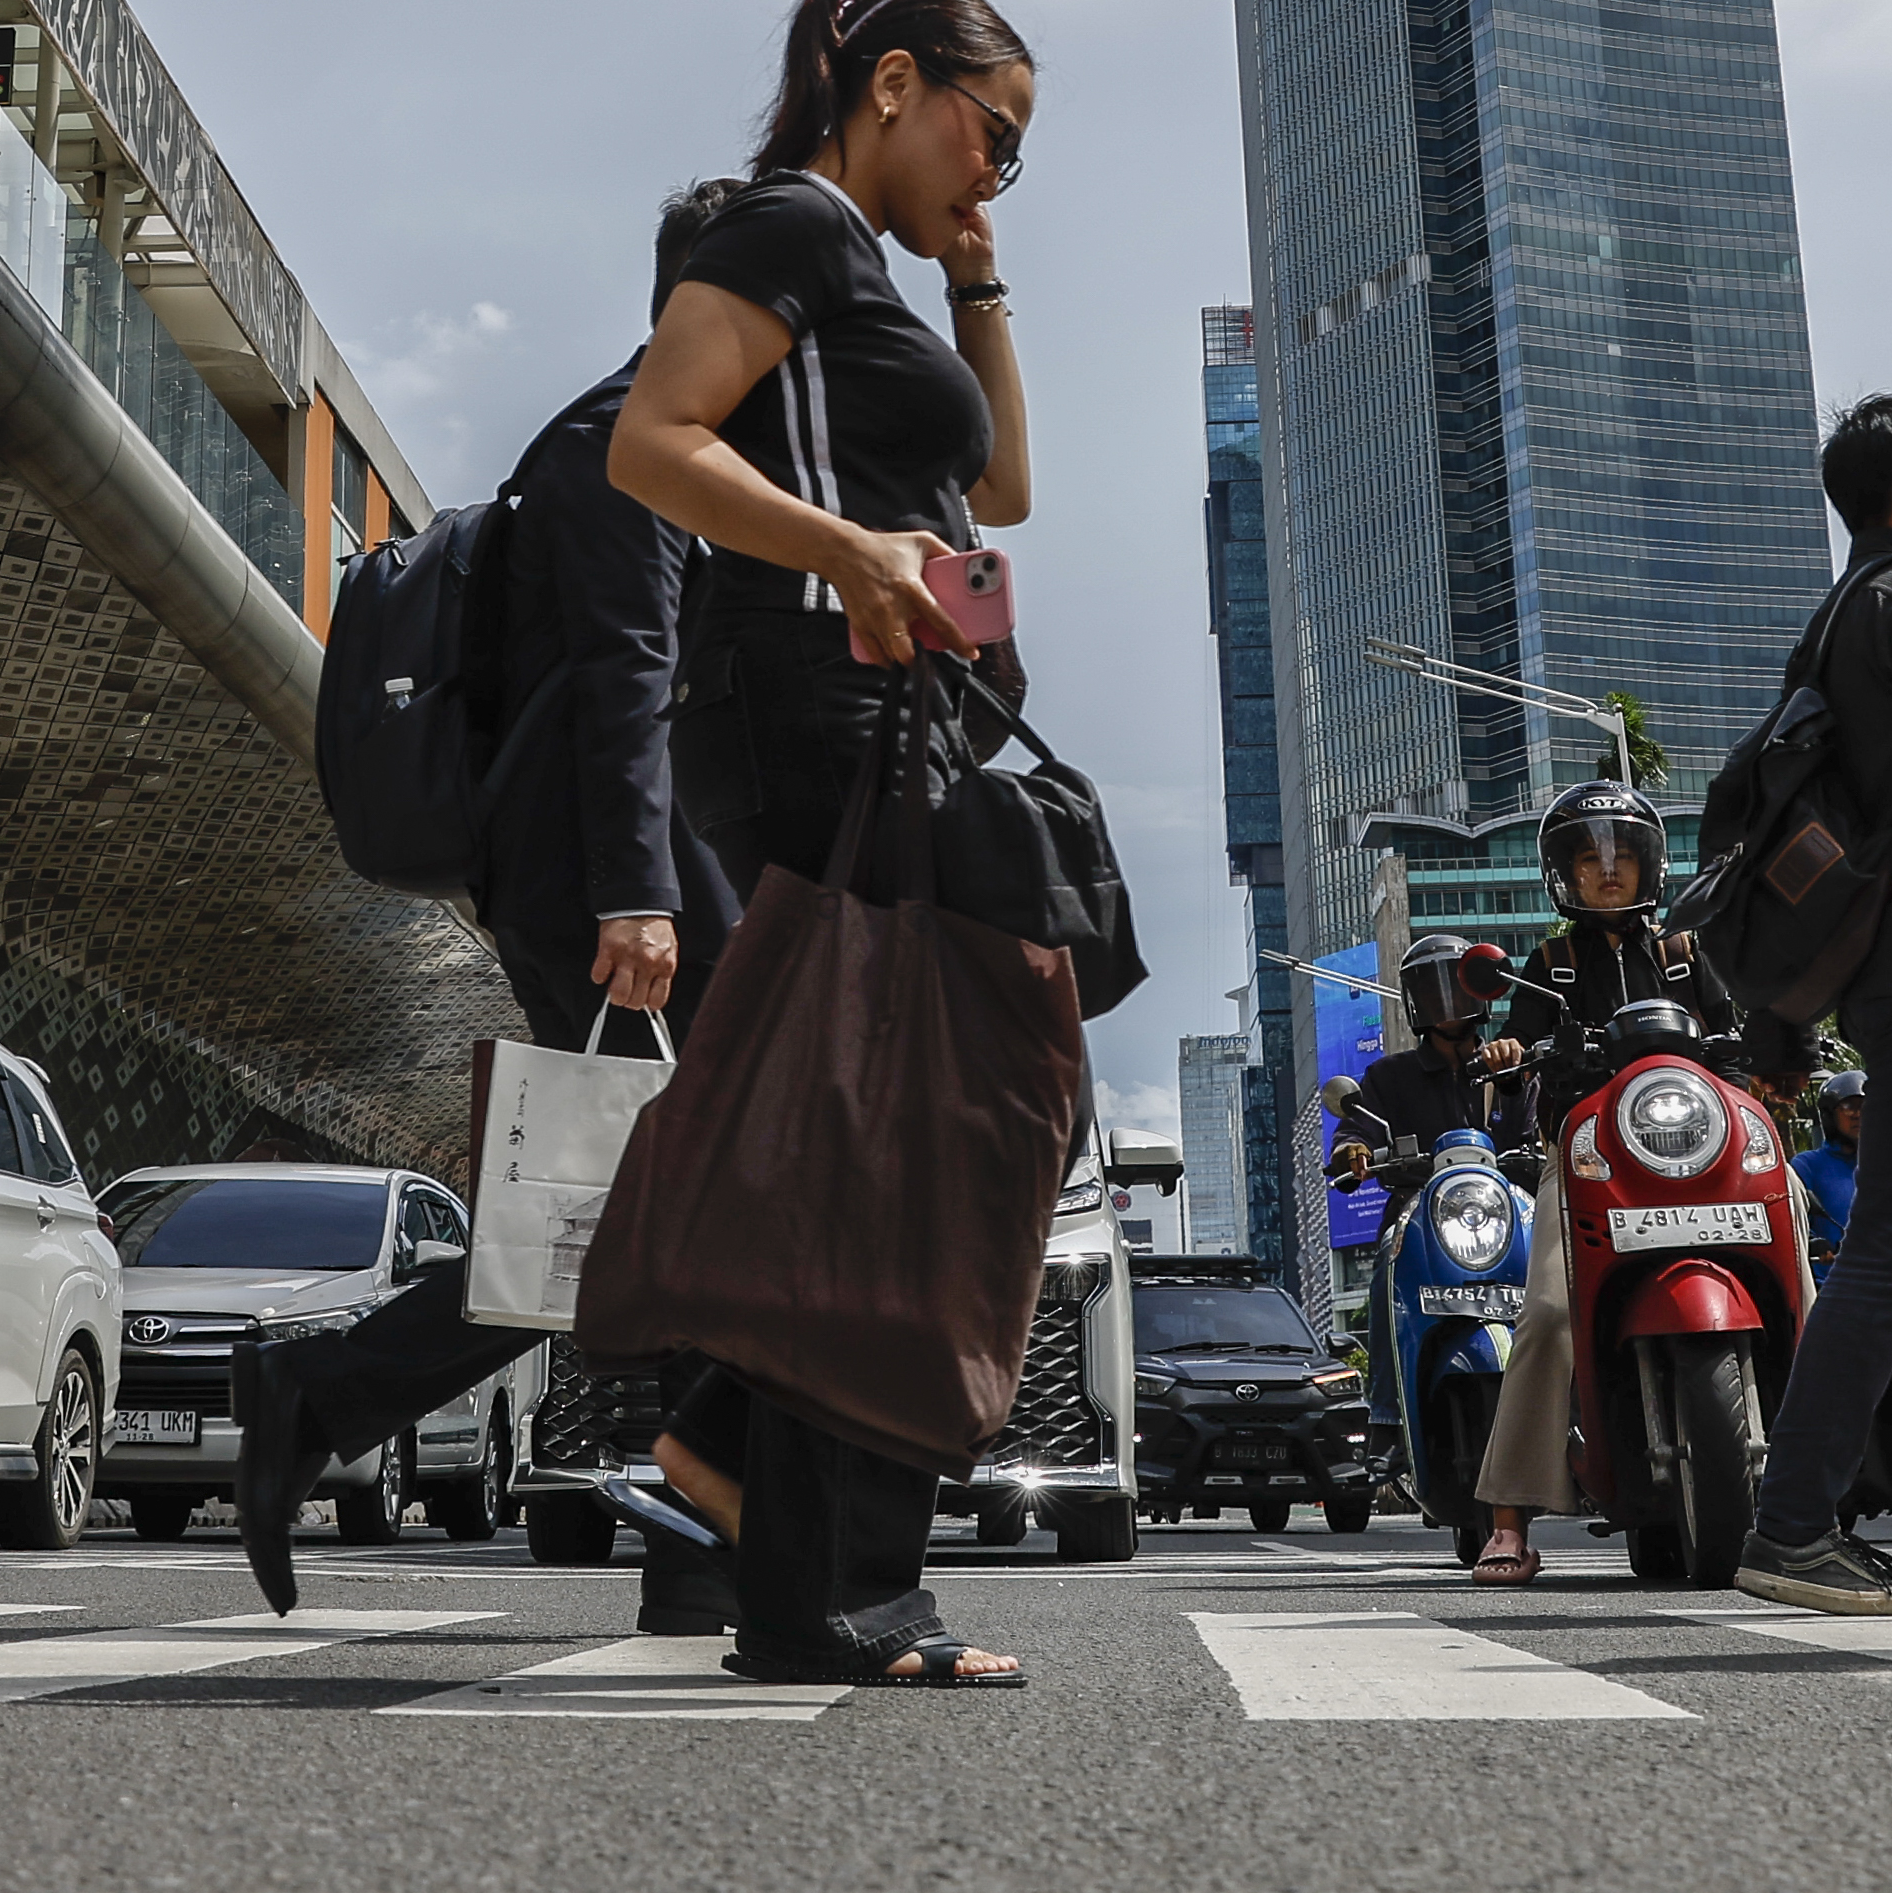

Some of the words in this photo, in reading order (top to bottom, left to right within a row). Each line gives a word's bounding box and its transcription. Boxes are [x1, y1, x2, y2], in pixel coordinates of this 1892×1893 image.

[1637, 1014, 1672, 1023] HONDA
[1614, 1211, 1627, 1229] B
[1641, 1210, 1699, 1227] 4814
[1422, 1287, 1434, 1299] B
[161, 1412, 193, 1432] UKM
